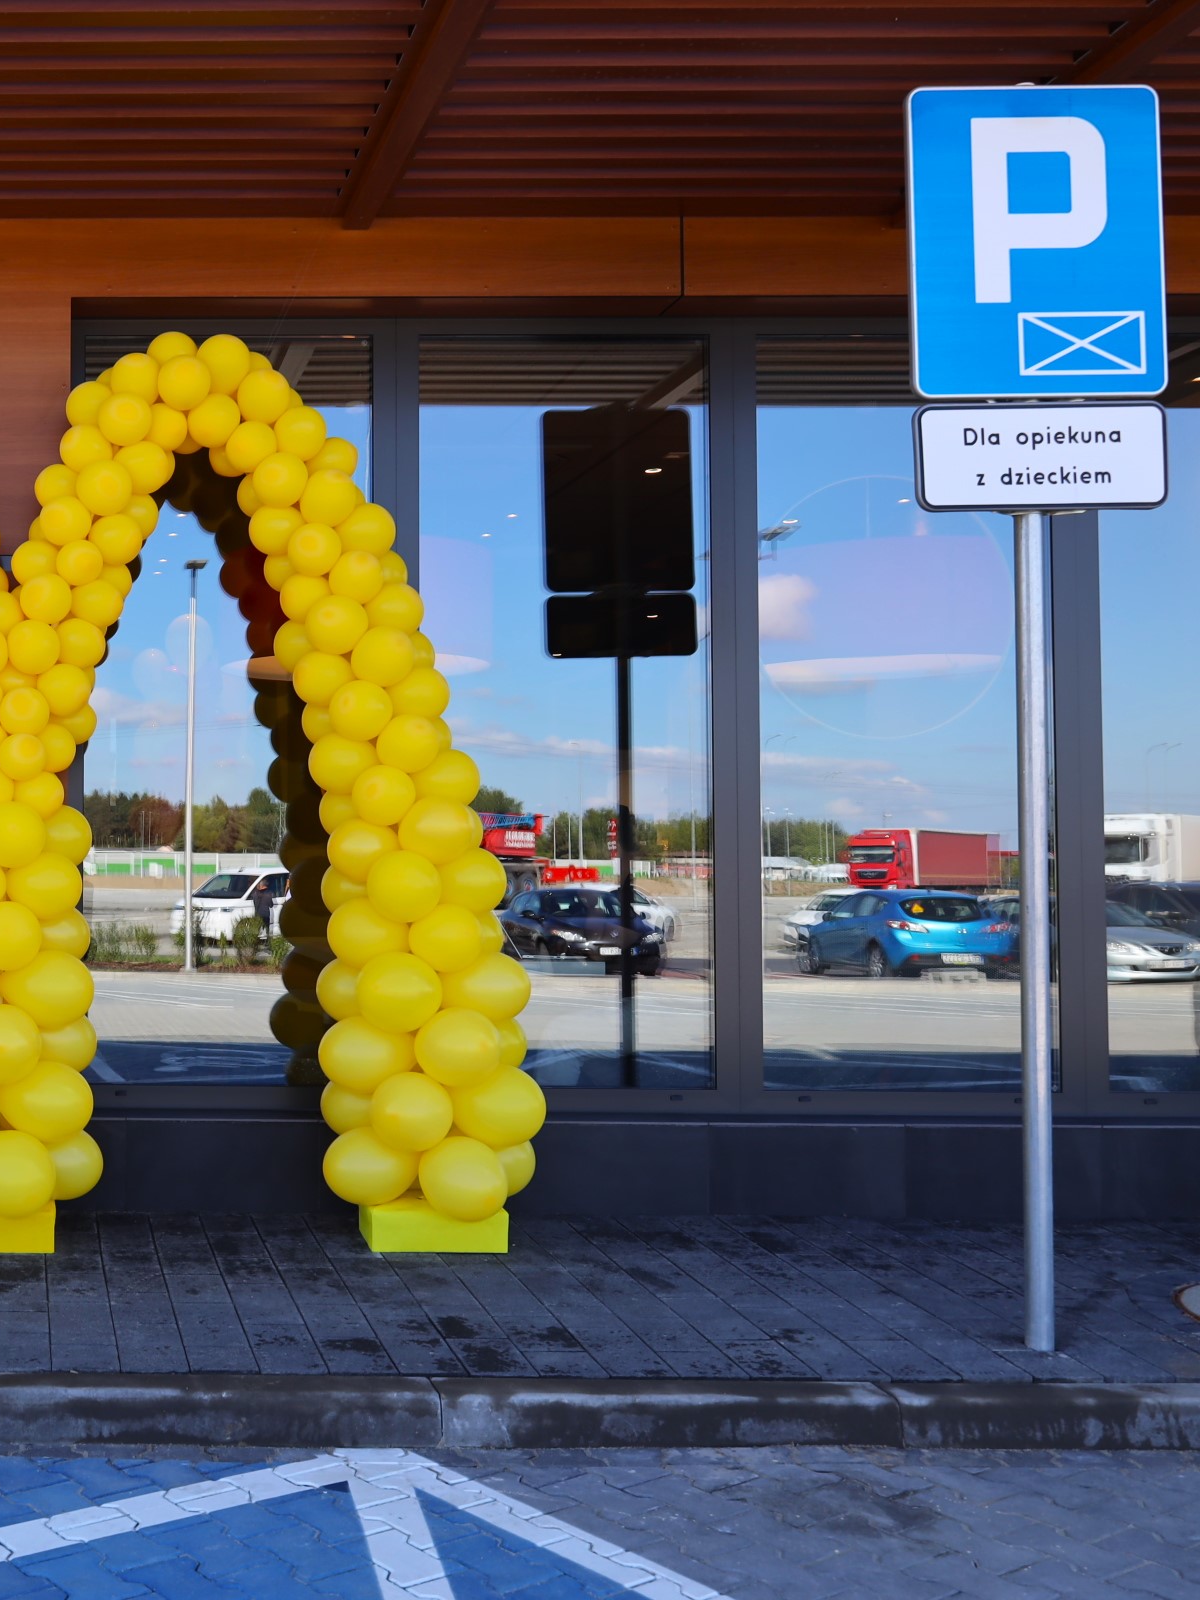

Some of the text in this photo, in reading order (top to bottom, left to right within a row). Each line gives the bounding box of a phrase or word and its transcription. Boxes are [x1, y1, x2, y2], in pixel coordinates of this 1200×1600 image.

[970, 116, 1108, 303] P
[963, 425, 1122, 450] Dla opiekuna
[976, 466, 1112, 486] z dzieckiem
